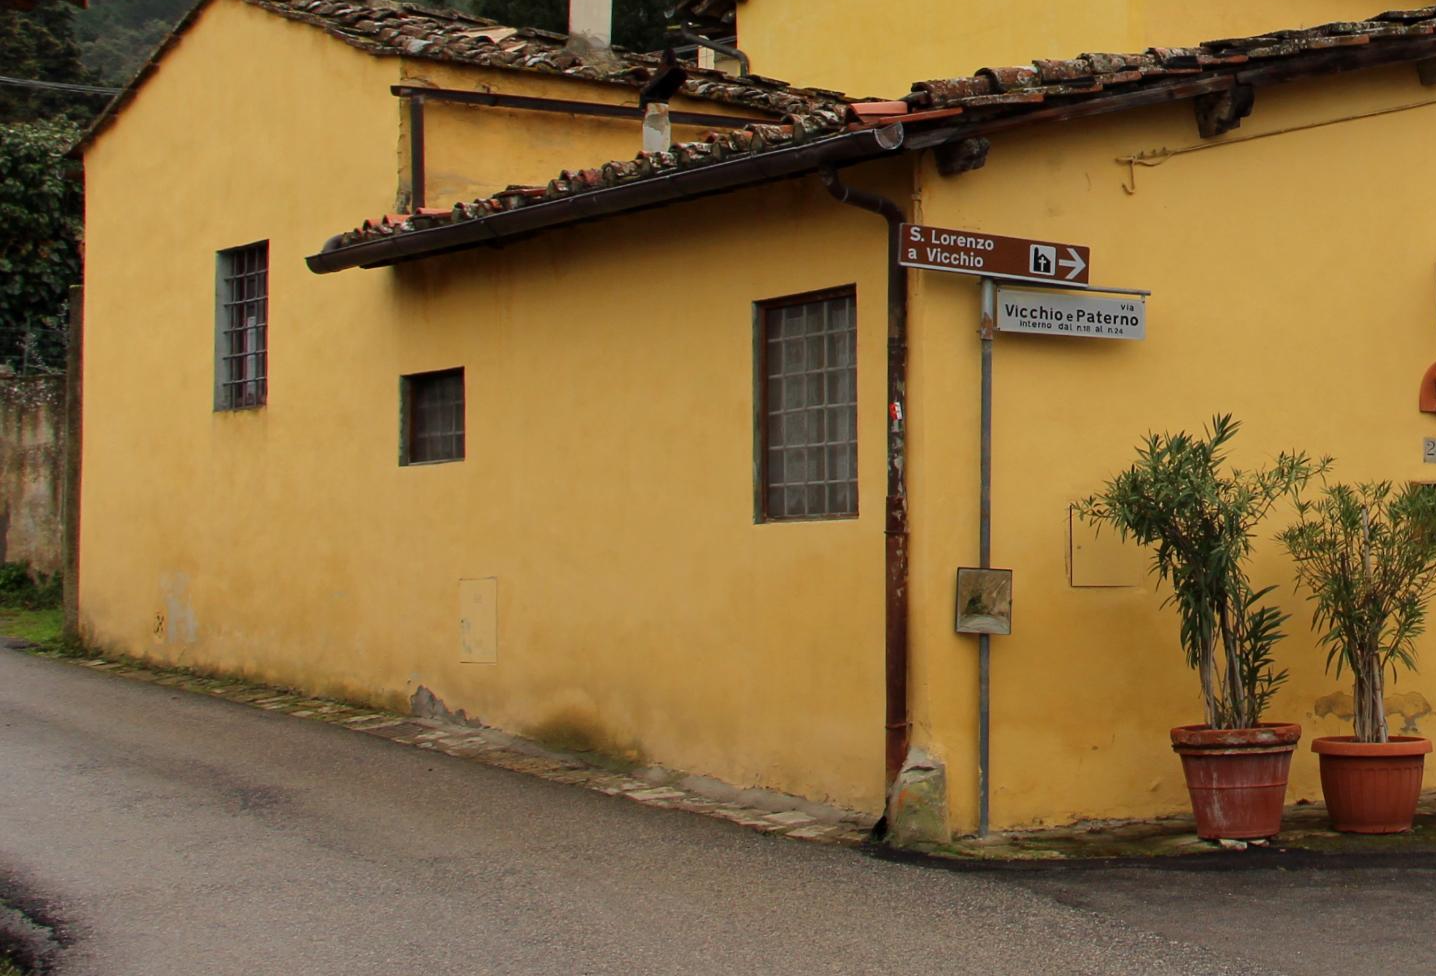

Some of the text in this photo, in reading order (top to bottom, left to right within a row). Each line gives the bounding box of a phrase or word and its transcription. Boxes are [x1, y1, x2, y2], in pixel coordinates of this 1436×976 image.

[910, 226, 994, 250] S. Lorenzo
[908, 247, 984, 267] a Vicchio
[1005, 304, 1139, 326] Vicchio e Paterno
[1120, 304, 1135, 312] via
[1058, 323, 1073, 331] dal
